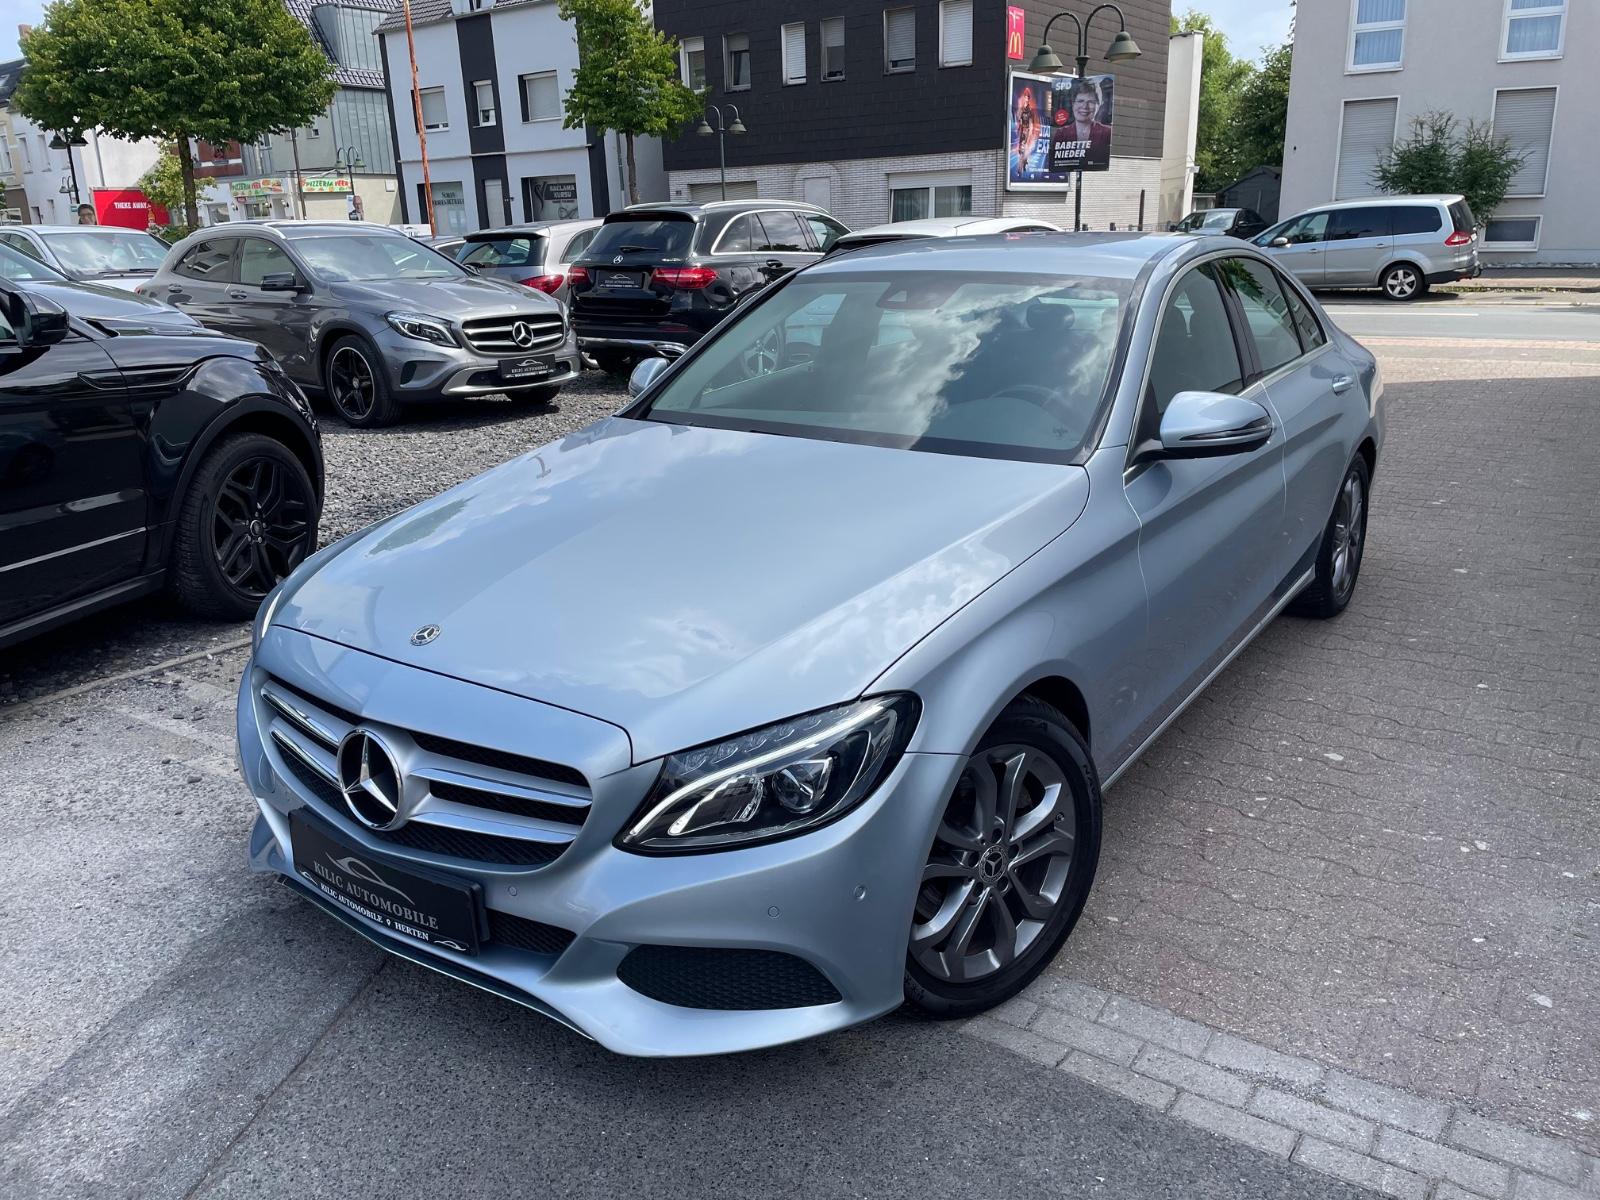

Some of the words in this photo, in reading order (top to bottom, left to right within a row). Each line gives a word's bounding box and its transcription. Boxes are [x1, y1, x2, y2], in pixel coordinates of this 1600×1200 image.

[1055, 82, 1072, 90] SPD
[1054, 140, 1092, 150] BABETTE
[1054, 149, 1086, 158] NIEDER
[313, 860, 344, 889] KILIC
[346, 881, 439, 930] AUTOMOBILE
[320, 882, 338, 899] KILIC
[338, 894, 384, 924] AUTOMOBILE
[394, 921, 429, 941] HERTEN
